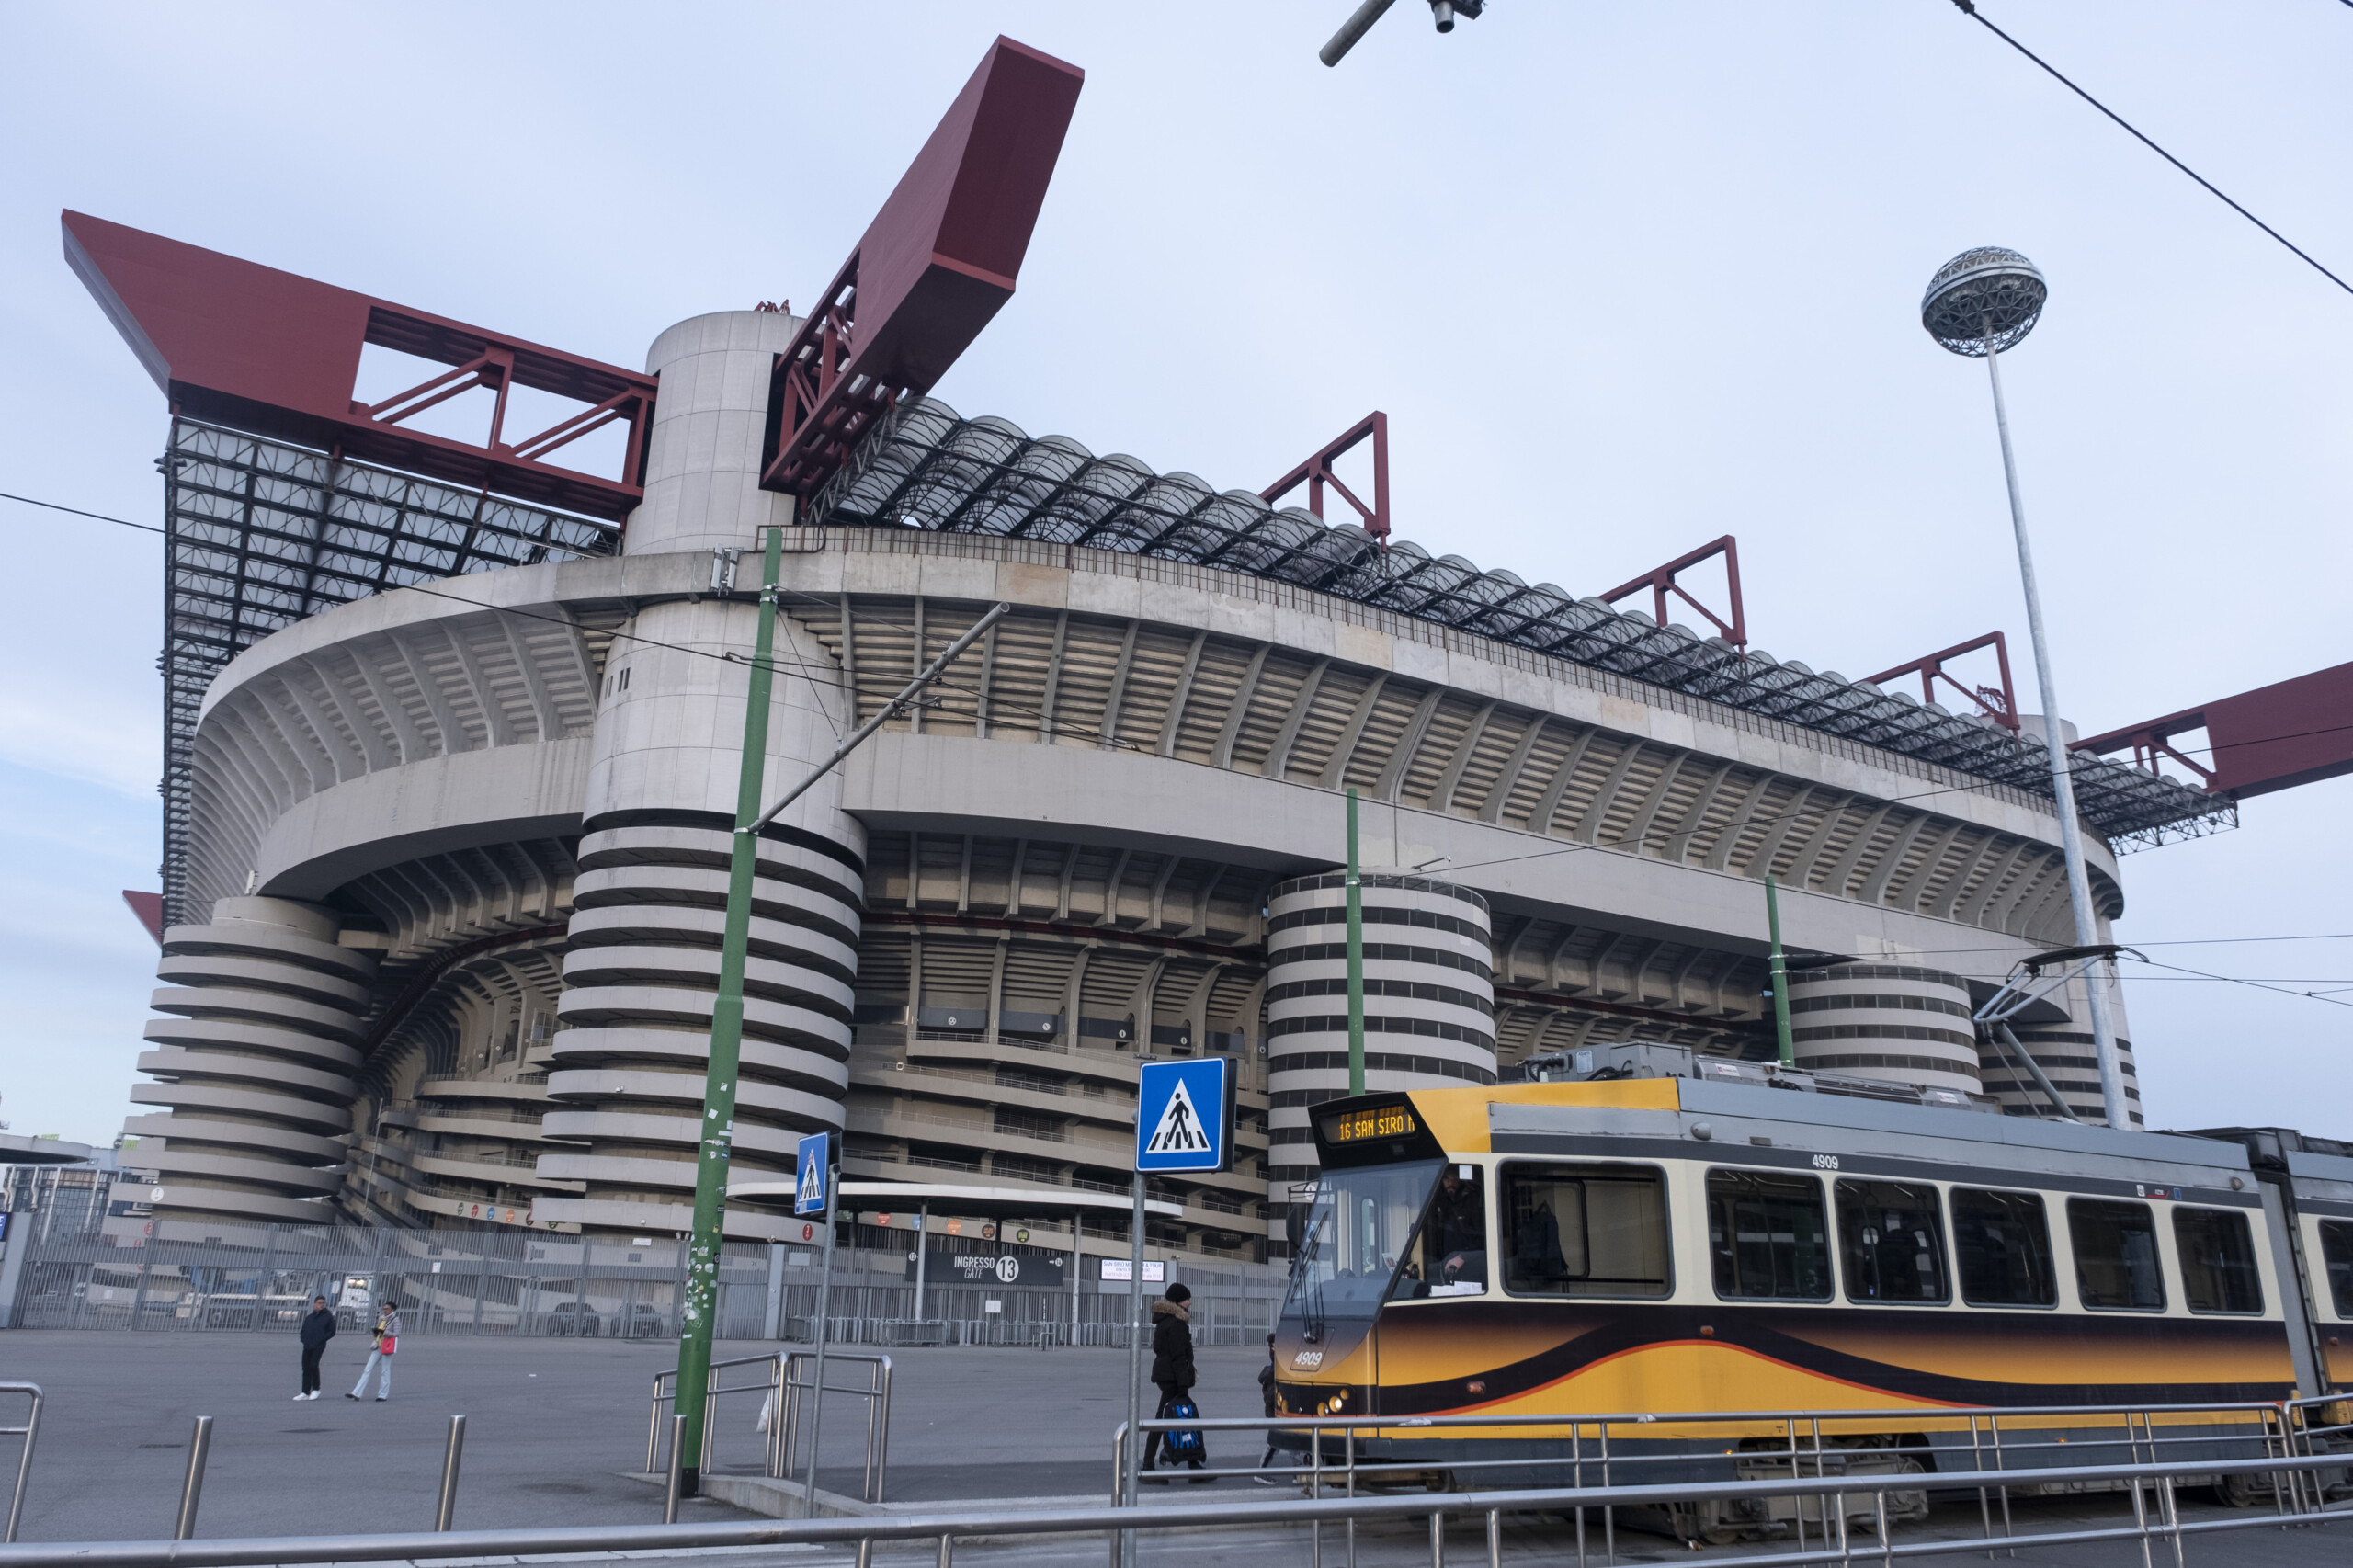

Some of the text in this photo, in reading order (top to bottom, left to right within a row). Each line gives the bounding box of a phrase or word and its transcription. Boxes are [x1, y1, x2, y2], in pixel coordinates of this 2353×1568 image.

[1340, 1122, 1351, 1141] 16
[1355, 1119, 1374, 1138] SAN
[1378, 1115, 1404, 1135] SIRO
[1812, 1154, 1839, 1169] 4909
[954, 1256, 995, 1269] INGRESSO
[1000, 1259, 1016, 1278] 13
[964, 1267, 983, 1279] GATE
[1295, 1351, 1323, 1366] 4909
